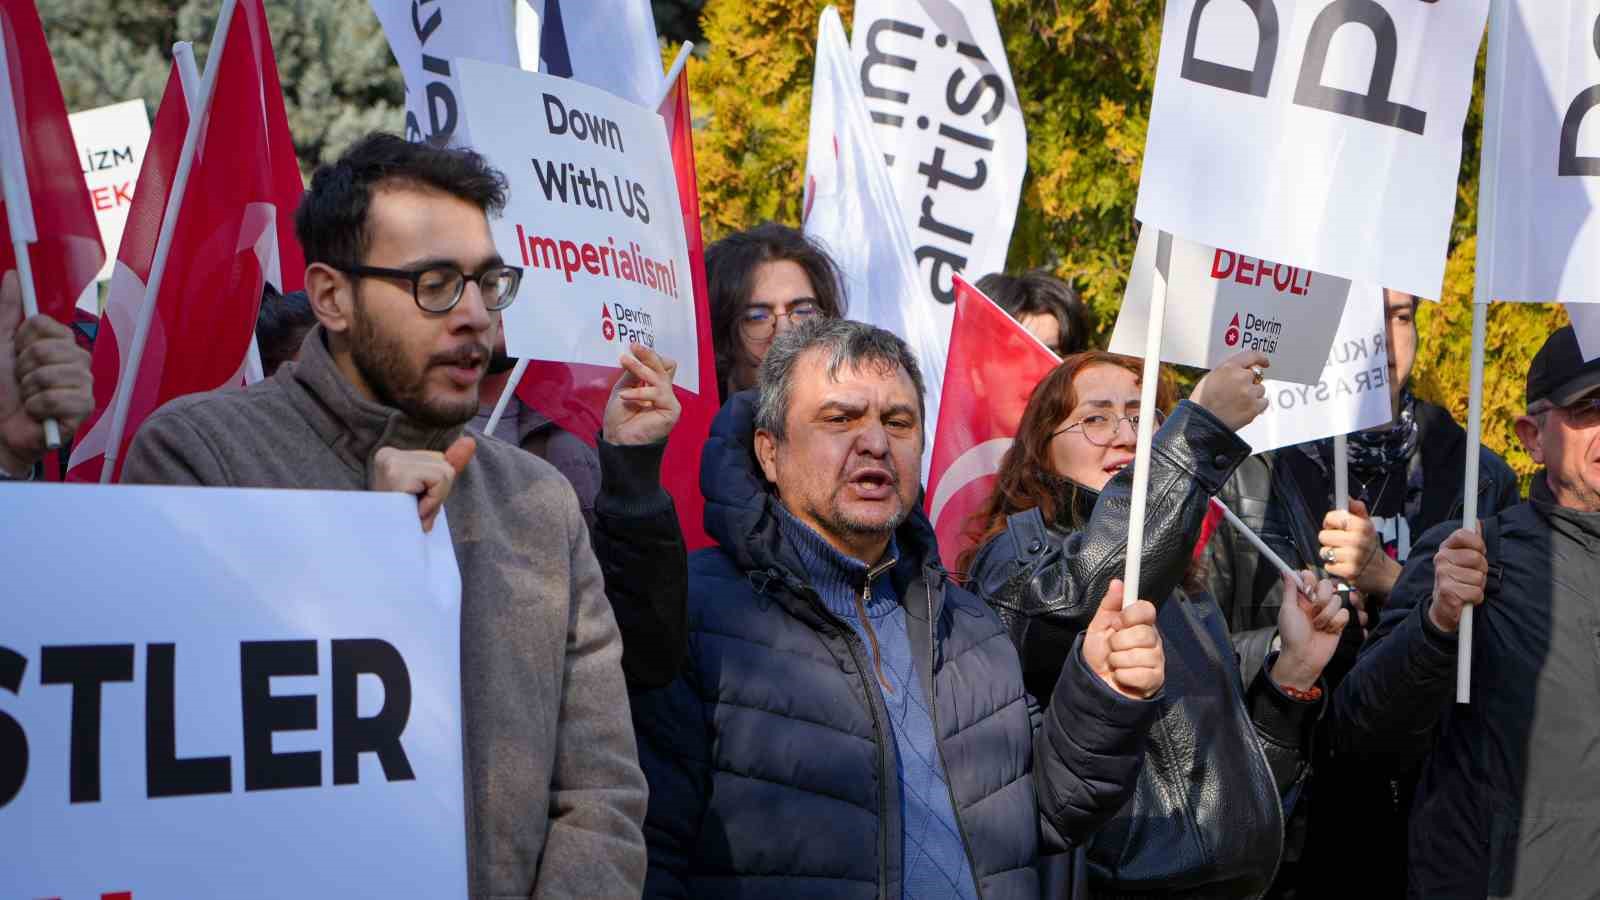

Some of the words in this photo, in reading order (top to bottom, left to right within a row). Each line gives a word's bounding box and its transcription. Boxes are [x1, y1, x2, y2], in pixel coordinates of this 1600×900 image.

[1292, 0, 1427, 136] P
[860, 18, 925, 167] im
[542, 92, 624, 153] Down
[82, 146, 134, 173] İZM
[532, 158, 613, 213] With
[615, 175, 651, 225] US
[516, 224, 679, 299] Imperialism!
[614, 303, 653, 329] Devrim
[618, 323, 655, 348] Partisi
[1245, 312, 1282, 335] Devrim
[1241, 331, 1279, 353] Partisi
